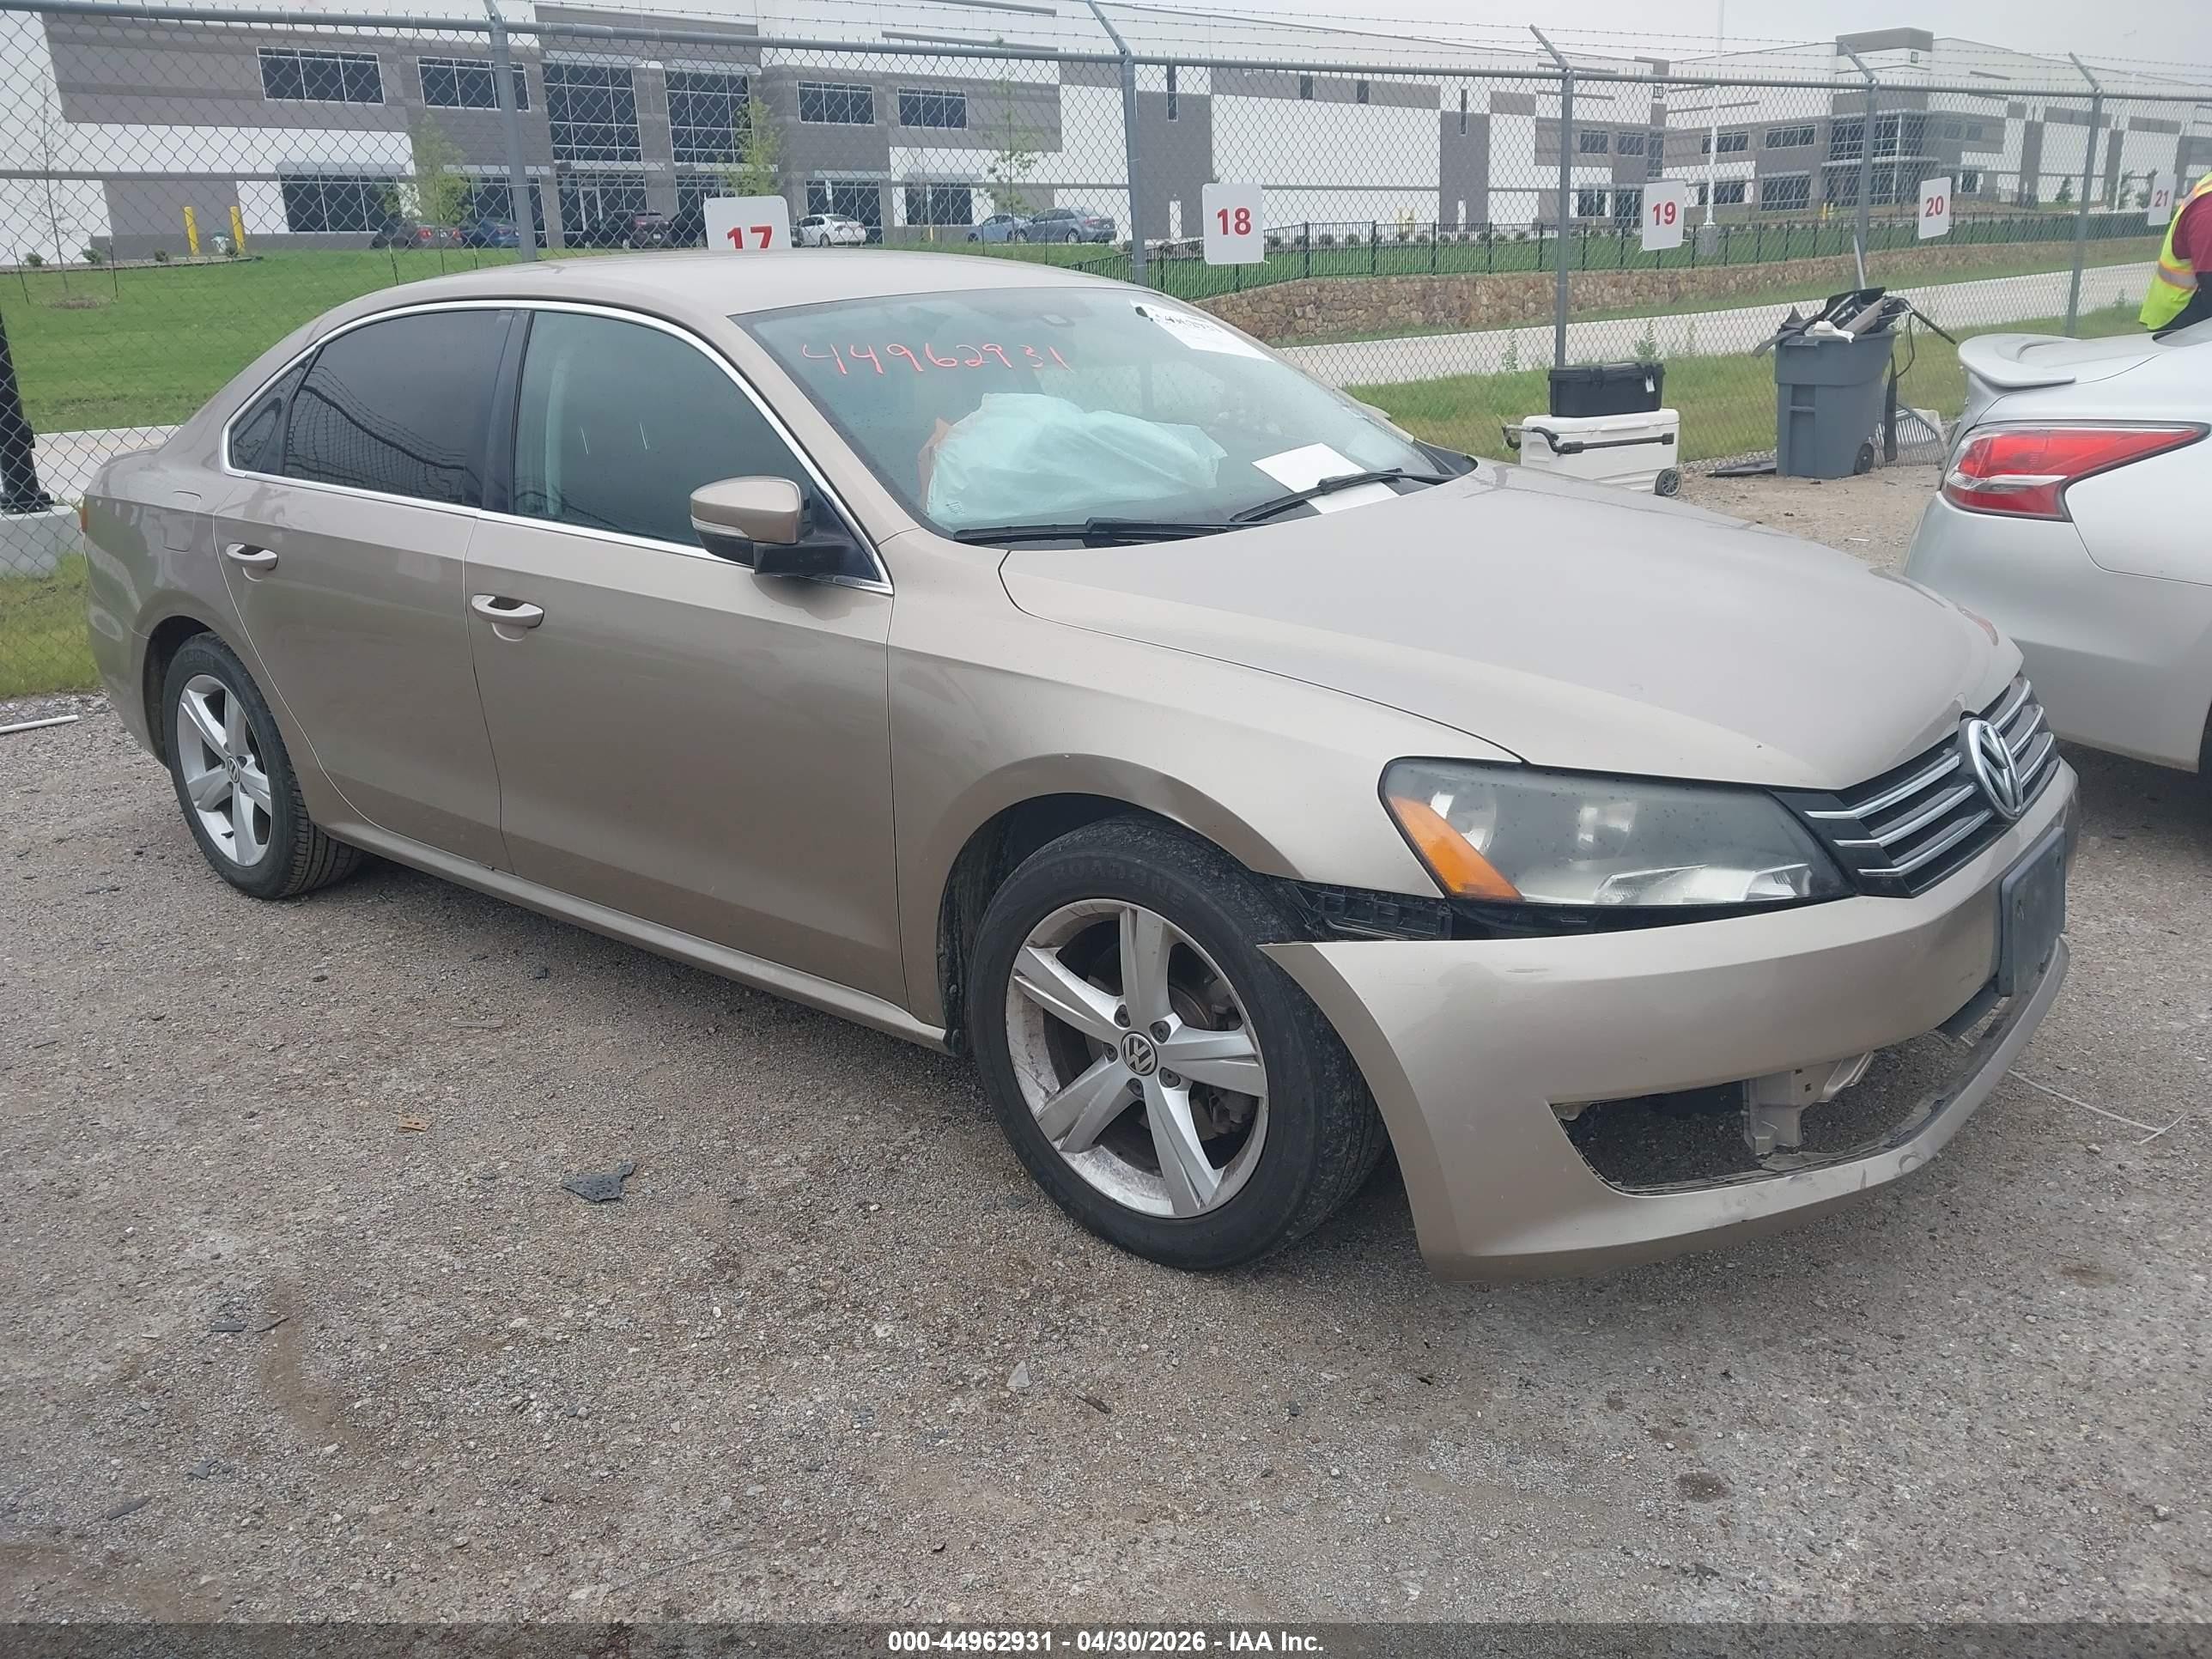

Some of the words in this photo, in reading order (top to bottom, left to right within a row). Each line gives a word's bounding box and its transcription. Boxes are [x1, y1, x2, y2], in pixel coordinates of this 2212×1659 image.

[1925, 196, 1944, 217] 20
[2154, 189, 2169, 207] 21
[1217, 208, 1251, 235] 18
[1653, 202, 1676, 226] 19
[727, 226, 772, 249] 17
[802, 343, 1074, 374] 44962931
